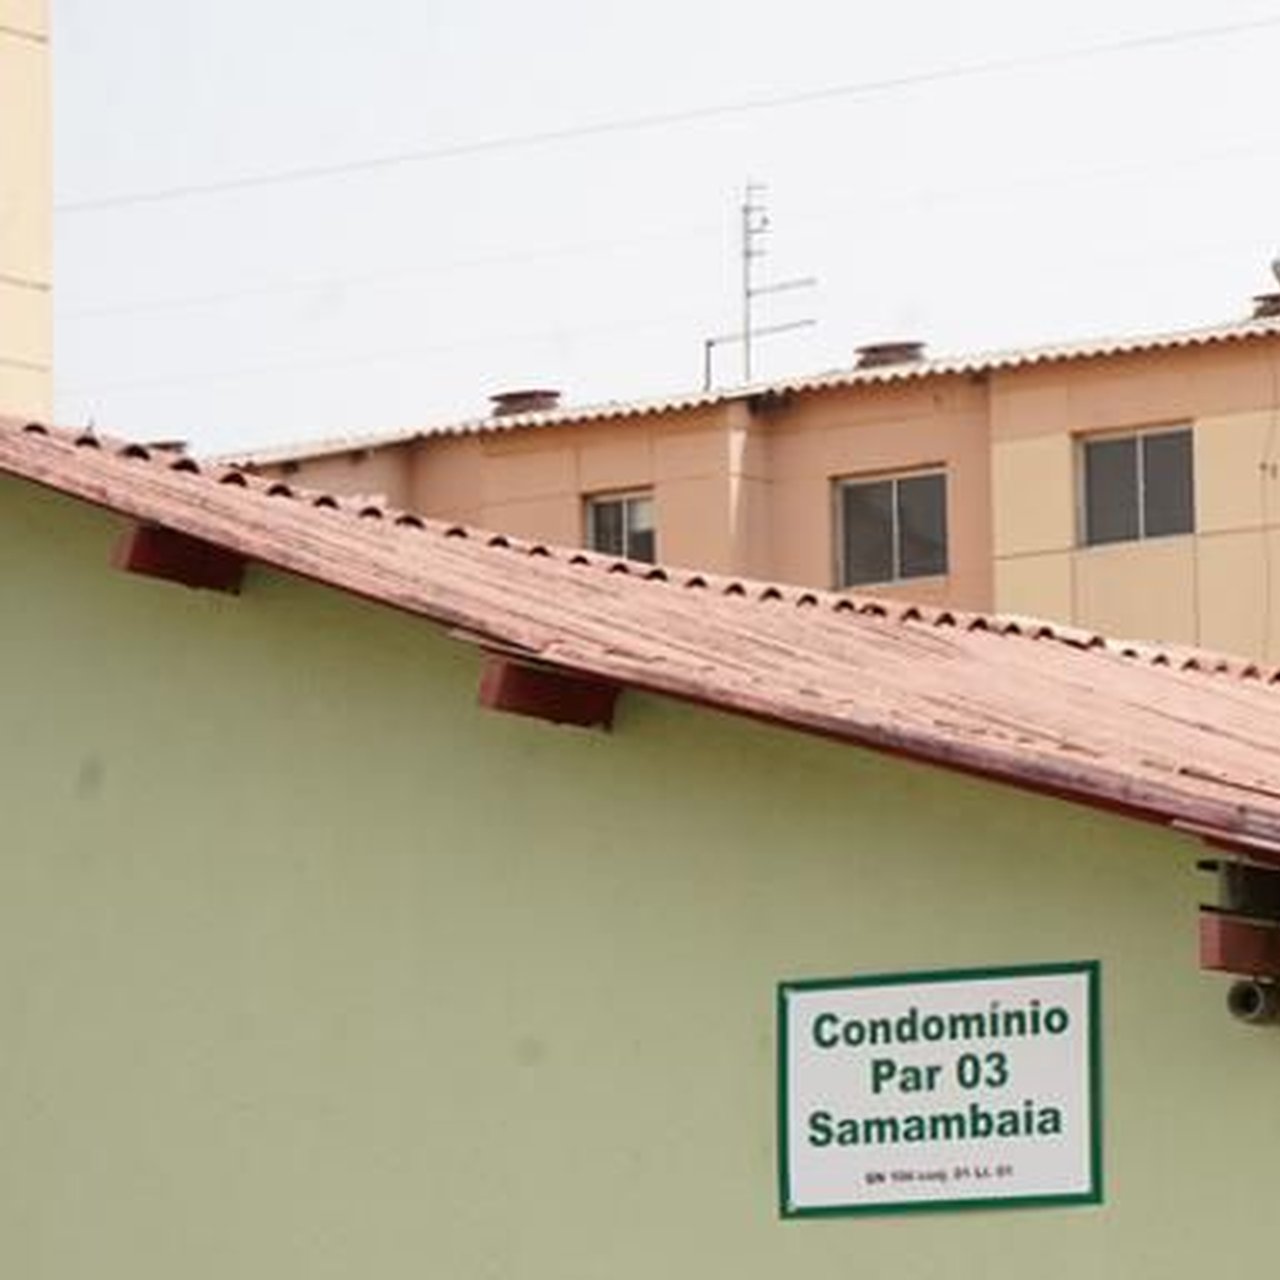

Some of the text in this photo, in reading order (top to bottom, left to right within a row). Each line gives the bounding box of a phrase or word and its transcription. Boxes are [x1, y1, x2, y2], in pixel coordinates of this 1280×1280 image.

[812, 1000, 1070, 1049] Condomínio
[871, 1052, 1010, 1095] Par 03
[808, 1100, 1063, 1148] Samambaia
